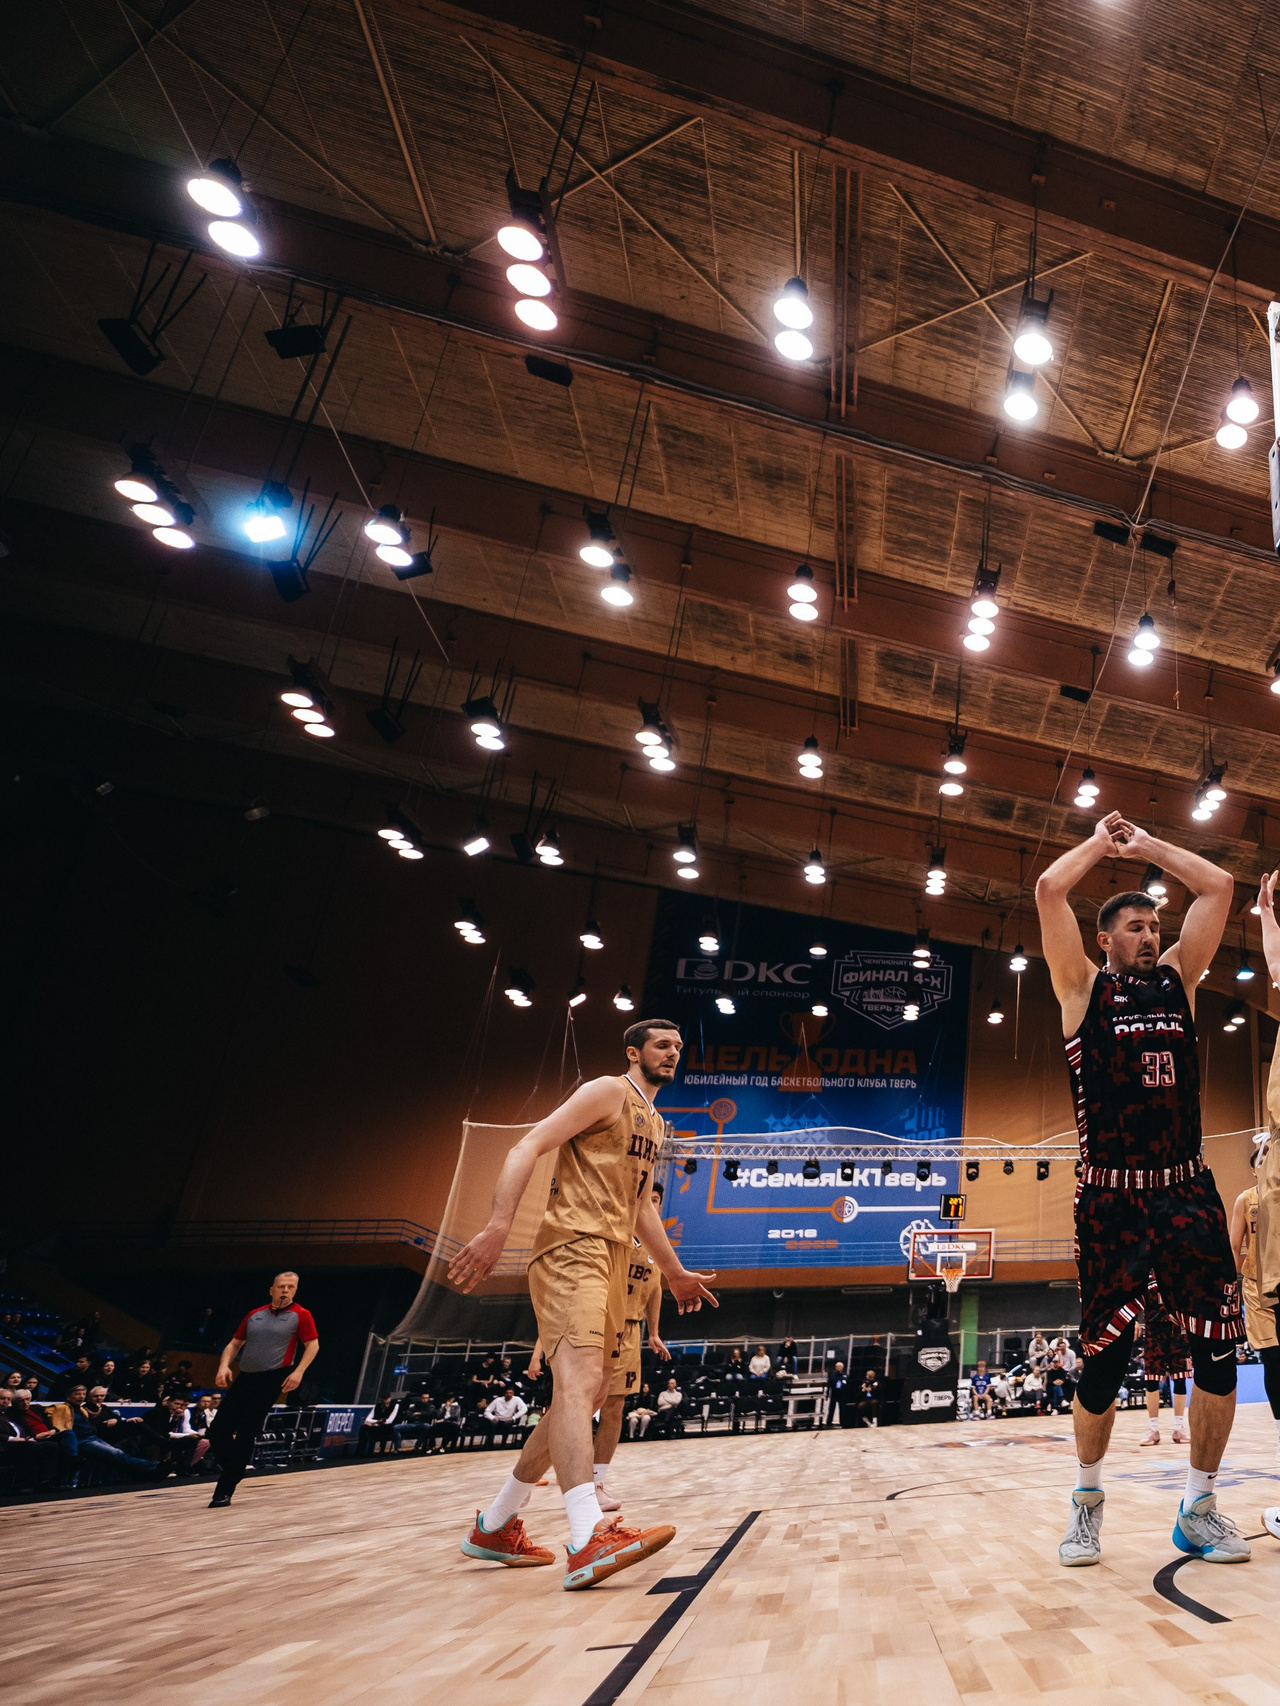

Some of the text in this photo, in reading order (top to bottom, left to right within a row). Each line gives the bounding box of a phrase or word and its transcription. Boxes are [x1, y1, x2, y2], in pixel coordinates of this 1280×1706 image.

[863, 958, 907, 967] ЧЕМПИОНАТ
[723, 960, 812, 984] DKC
[843, 970, 908, 984] ФИНАЛ
[675, 985, 810, 999] Титульй спонсор
[862, 1004, 892, 1012] ТВЕРЬ
[686, 1045, 918, 1075] ЦЕЛЬ ОДНА
[1141, 1051, 1176, 1087] 33
[684, 1074, 917, 1089] ЮБИЛЕЙНЫЙ ГОД БАСКЕТБОЛЬНОГО КЛУБА ТВЕРЬ
